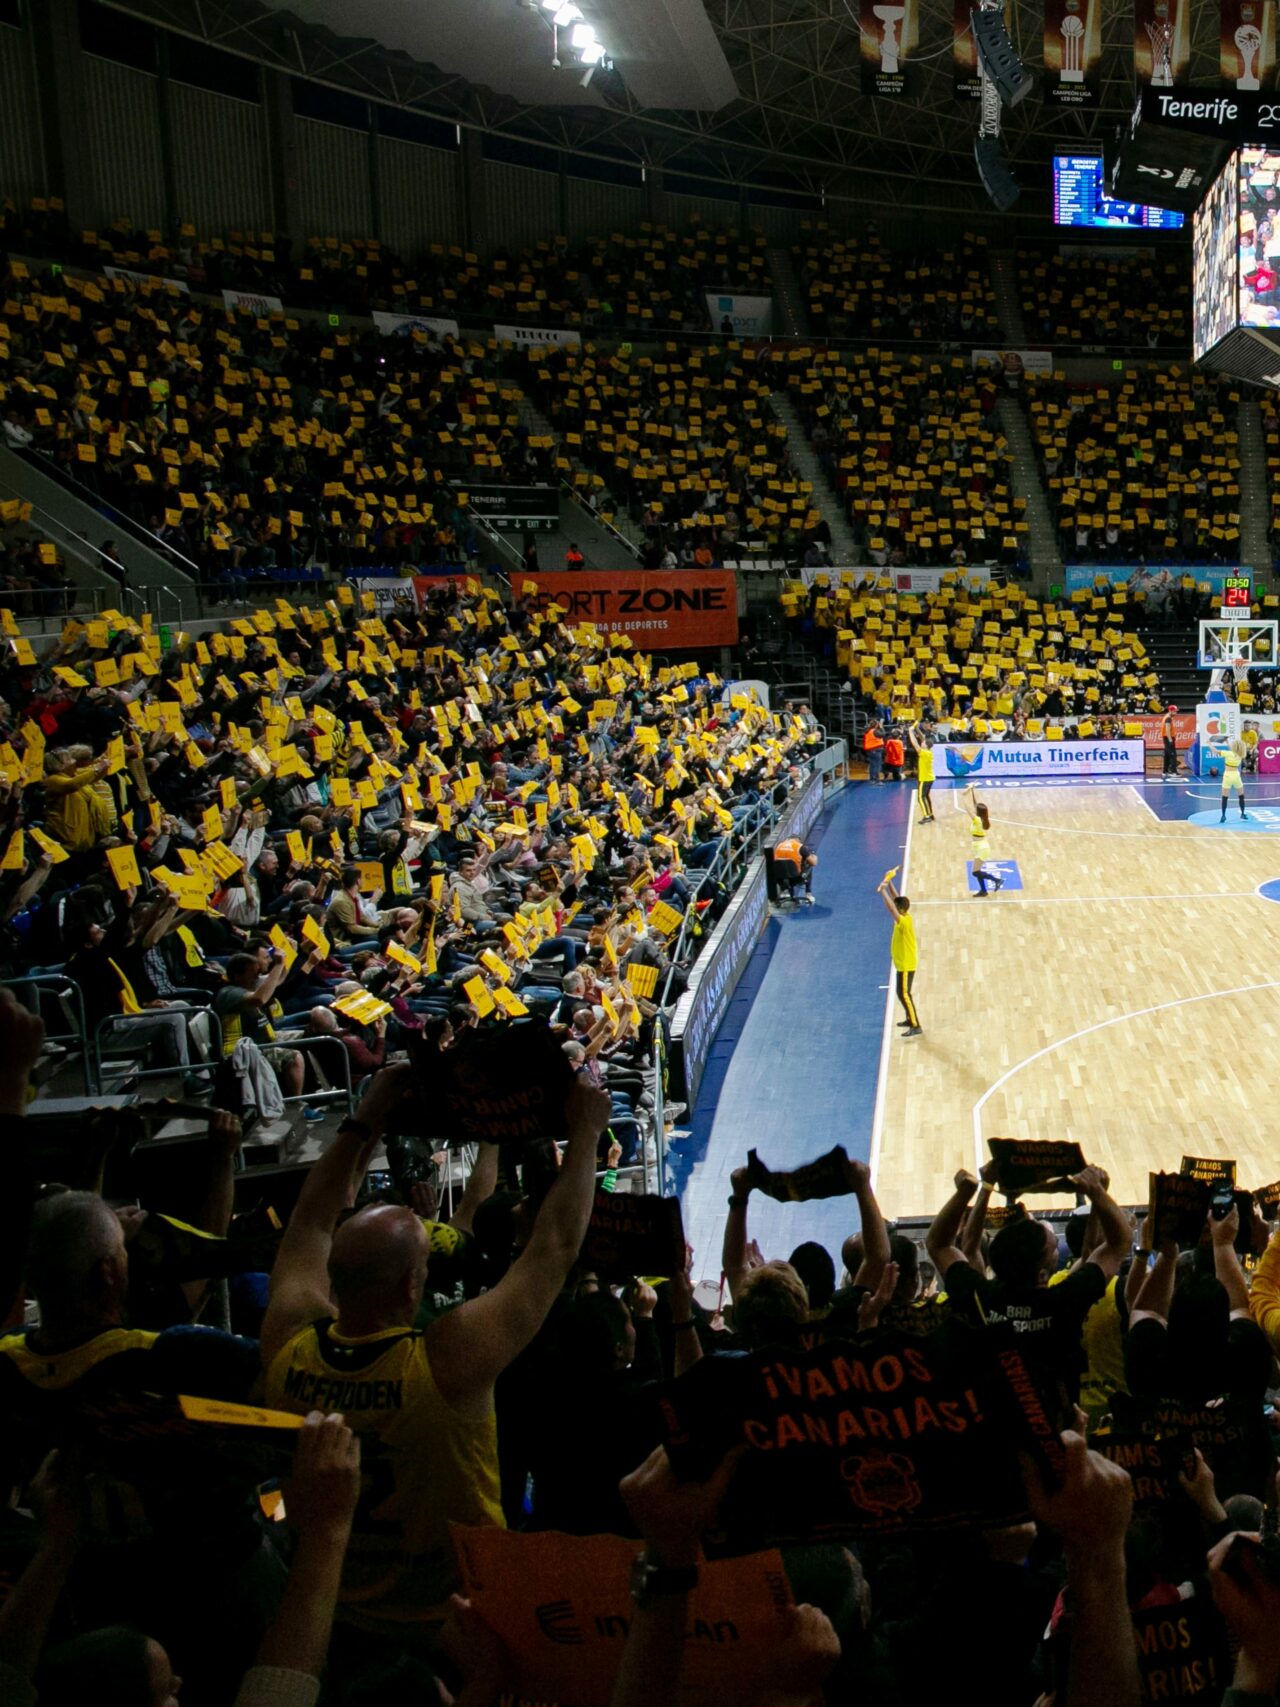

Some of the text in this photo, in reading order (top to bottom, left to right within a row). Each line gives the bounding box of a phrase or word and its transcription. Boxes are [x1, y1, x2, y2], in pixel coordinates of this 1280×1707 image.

[1158, 95, 1238, 125] Tenerife
[526, 520, 540, 529] EXIT
[1226, 578, 1249, 588] 03:50
[618, 587, 727, 613] ZONE
[1228, 588, 1248, 604] 24
[612, 622, 622, 632] DE
[624, 619, 669, 631] DEPORTES
[987, 747, 1130, 764] Mutua Tinerfeña
[1006, 1304, 1033, 1319] BAR
[1012, 1315, 1054, 1333] SPORT
[760, 1345, 935, 1403] ¡VAMOS
[284, 1367, 402, 1410] MCFADDEN
[741, 1386, 985, 1452] CANARIAS!
